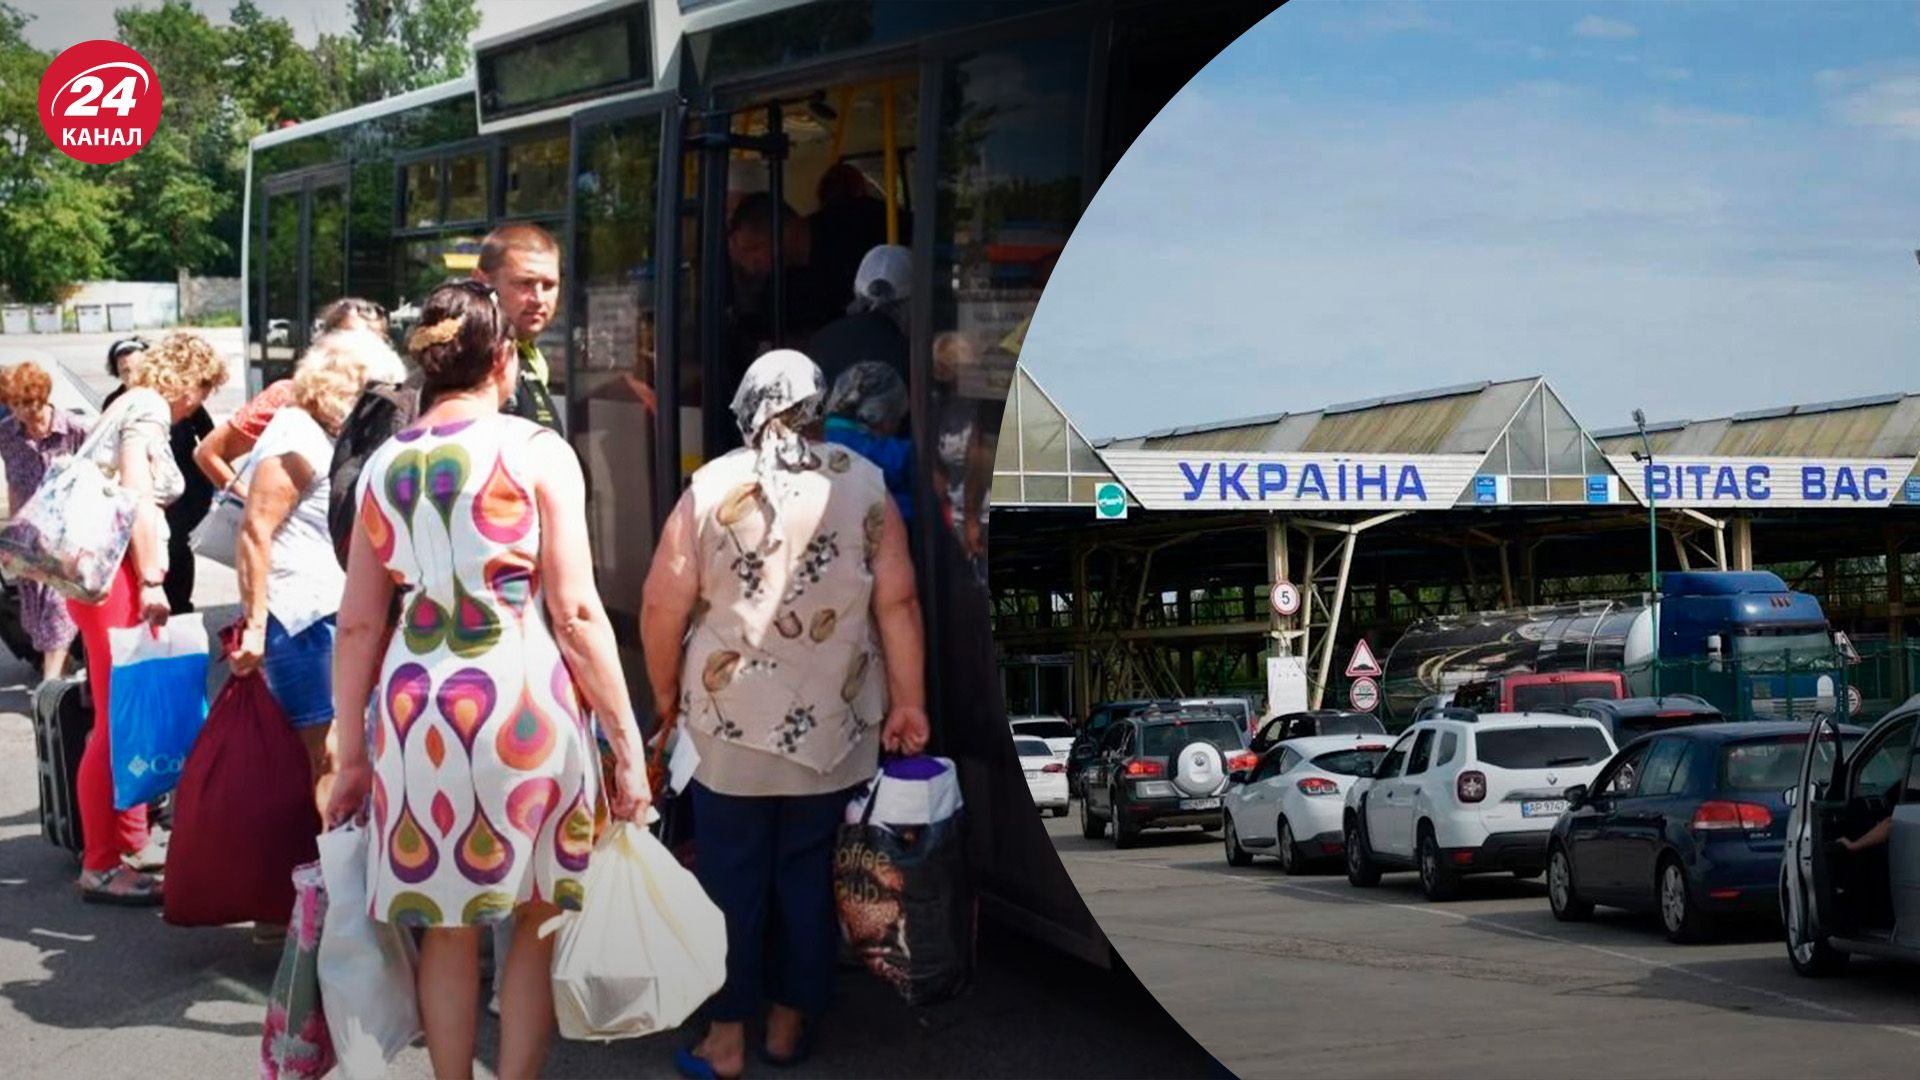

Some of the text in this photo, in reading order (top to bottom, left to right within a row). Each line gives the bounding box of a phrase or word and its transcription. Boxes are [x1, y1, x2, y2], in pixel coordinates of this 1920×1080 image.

[1178, 458, 1428, 501] УКРАЇНА
[1644, 464, 1770, 501] ВІТАЄ
[1801, 466, 1888, 502] ВАС
[1281, 590, 1291, 606] 5
